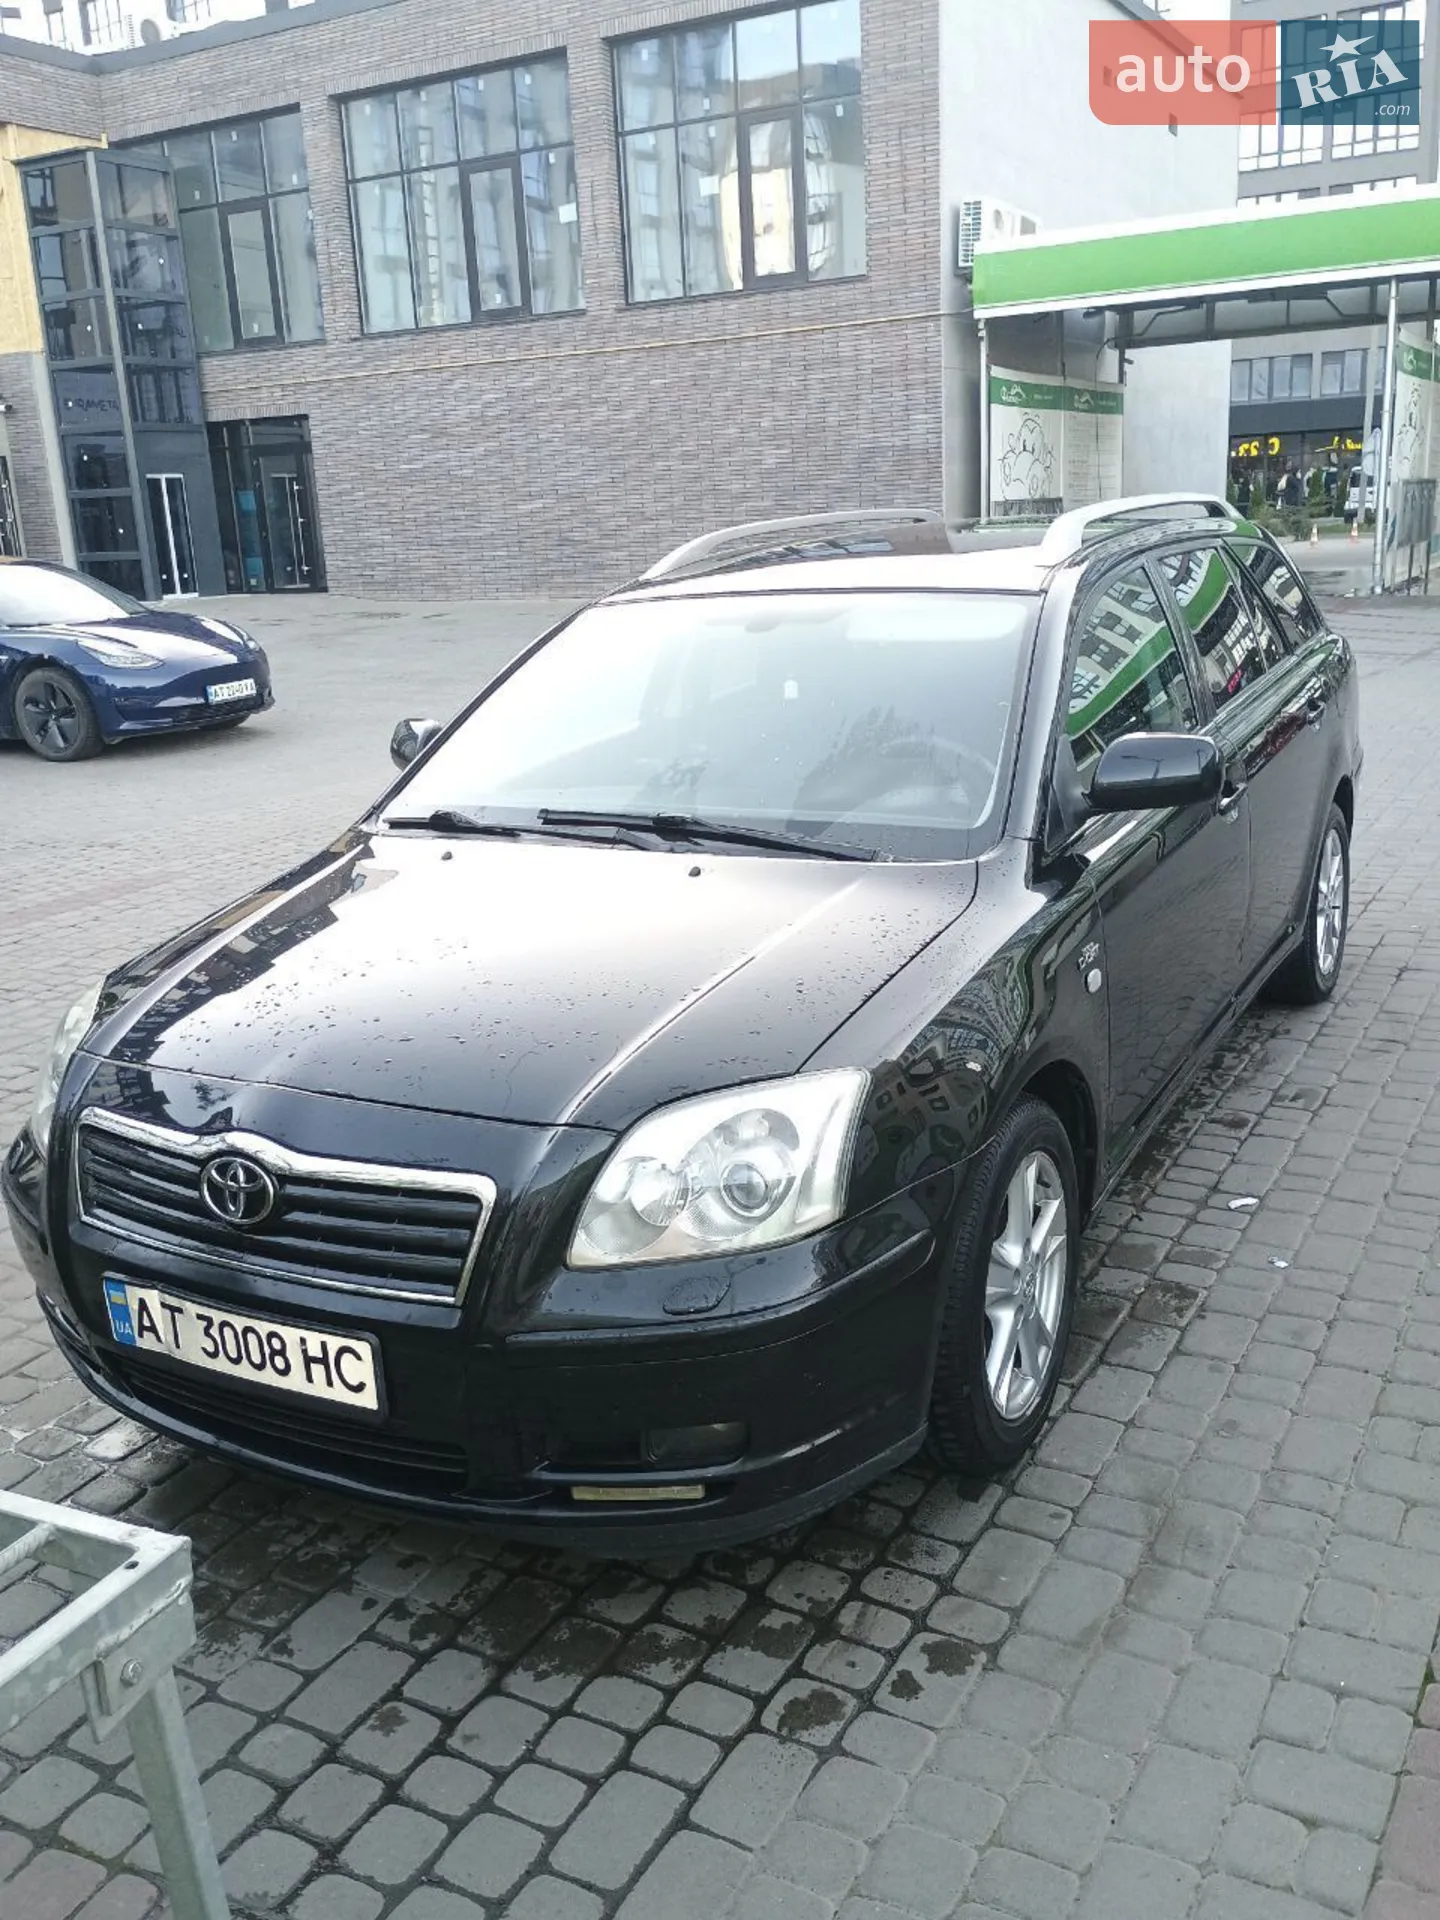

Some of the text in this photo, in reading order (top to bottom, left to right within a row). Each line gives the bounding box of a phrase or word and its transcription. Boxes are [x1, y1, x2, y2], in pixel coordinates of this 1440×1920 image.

[114, 1318, 133, 1336] UA
[136, 1296, 367, 1395] AT 3008 HC
